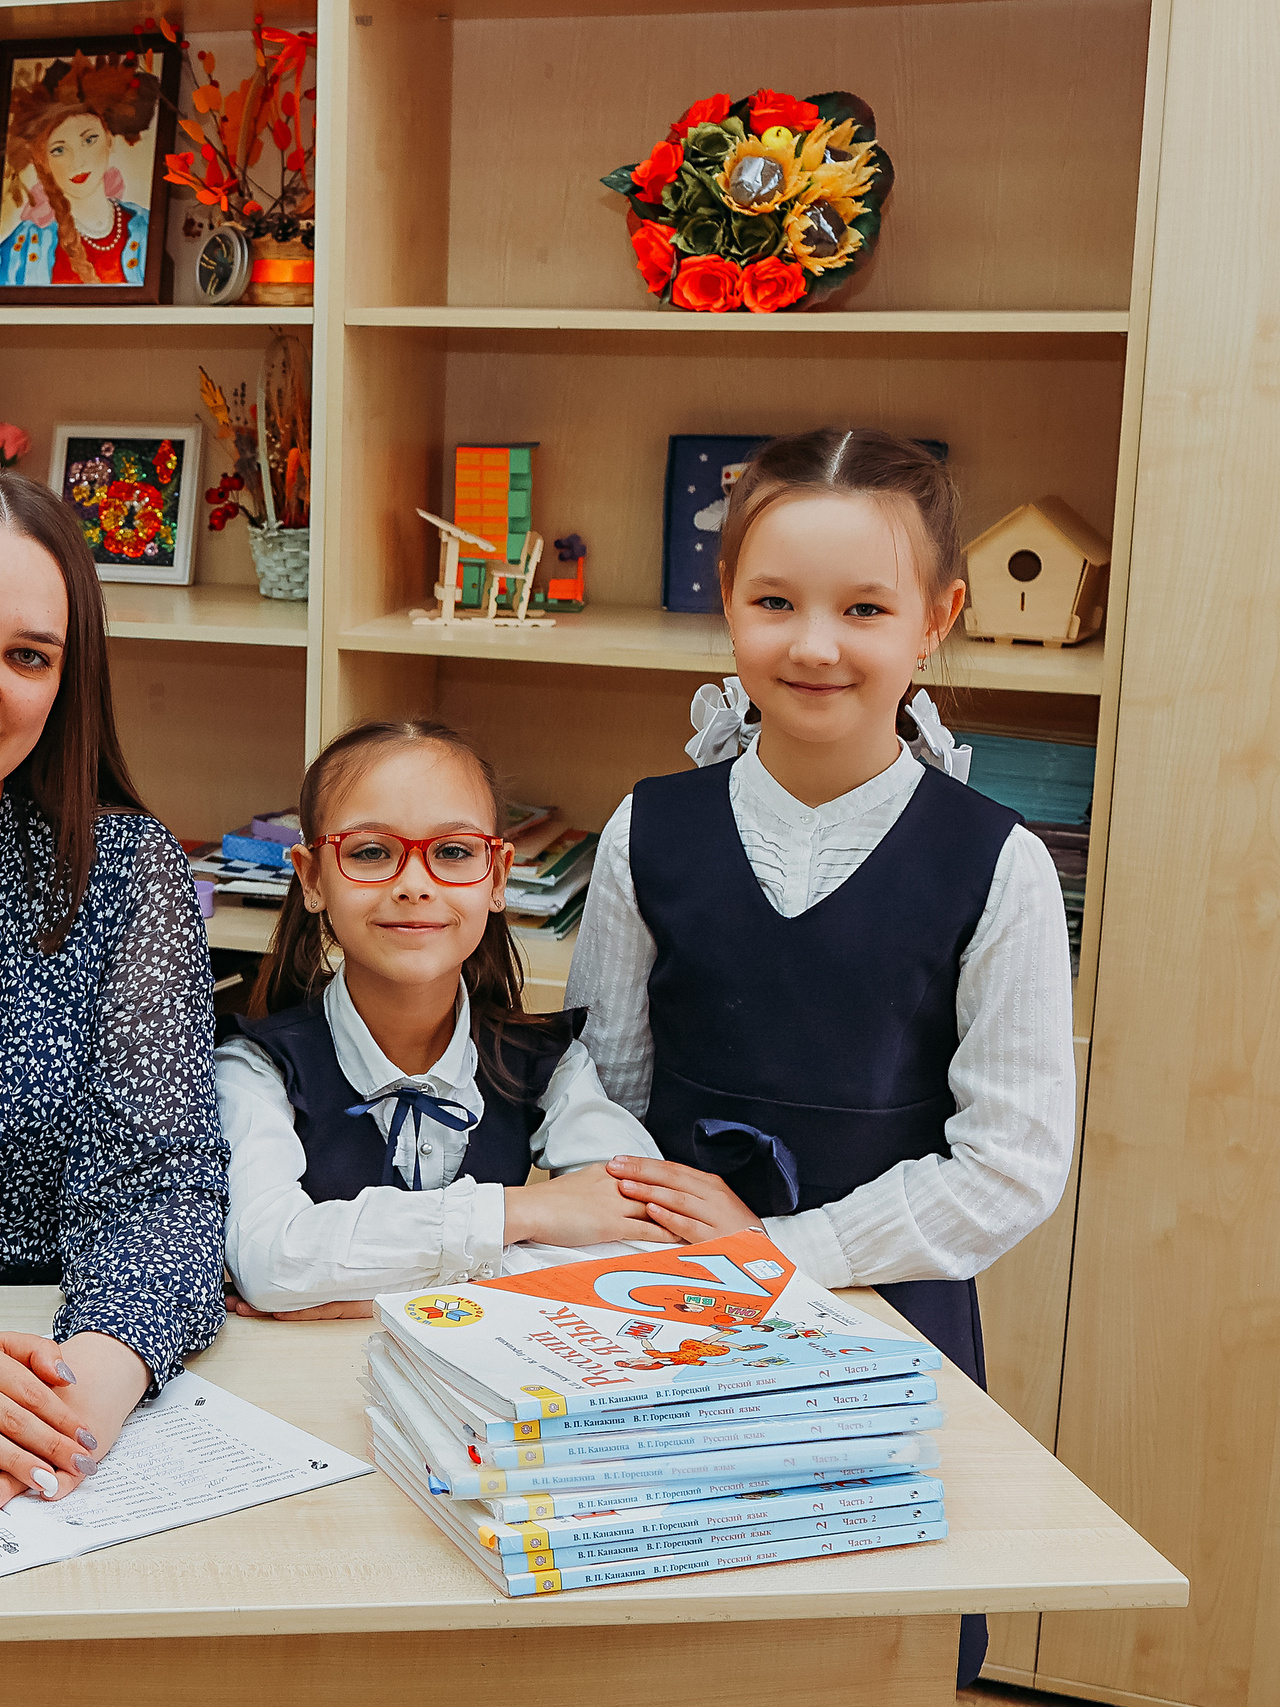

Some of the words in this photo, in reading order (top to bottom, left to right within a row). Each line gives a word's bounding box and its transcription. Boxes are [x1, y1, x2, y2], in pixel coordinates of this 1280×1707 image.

[593, 1255, 773, 1312] 2
[818, 1368, 830, 1379] 2
[844, 1364, 869, 1374] Часть
[871, 1361, 878, 1371] 2
[717, 1378, 752, 1392] Русский
[755, 1376, 777, 1386] язык
[608, 1392, 648, 1404] Канакина
[671, 1383, 711, 1397] Горецкий
[832, 1395, 860, 1404] Часть
[862, 1392, 868, 1402] 2
[805, 1397, 818, 1408] 2
[583, 1416, 625, 1427] Канакина
[649, 1409, 691, 1422] Горецкий
[698, 1405, 734, 1419] Русский
[738, 1404, 761, 1414] язык
[813, 1470, 825, 1480] 2
[709, 1480, 745, 1495] Русский
[748, 1478, 770, 1488] язык
[597, 1495, 638, 1507] Канакина
[662, 1486, 702, 1500] Горецкий
[838, 1497, 865, 1507] Часть
[868, 1494, 874, 1504] 2
[812, 1501, 824, 1513] 2
[706, 1512, 743, 1527] Русский
[746, 1510, 769, 1520] язык
[815, 1520, 828, 1531] 2
[842, 1516, 868, 1526] Часть
[871, 1513, 877, 1523] 2
[592, 1527, 634, 1539] Канакина
[659, 1518, 699, 1532] Горецкий
[710, 1530, 746, 1544] Русский
[750, 1527, 772, 1538] язык
[597, 1545, 638, 1557] Канакина
[663, 1536, 703, 1550] Горецкий
[821, 1541, 833, 1552] 2
[847, 1537, 873, 1547] Часть
[876, 1534, 882, 1544] 2
[717, 1553, 752, 1567] Русский
[756, 1550, 778, 1560] язык
[604, 1568, 645, 1581] Канакина
[669, 1558, 710, 1572] Горецкий
